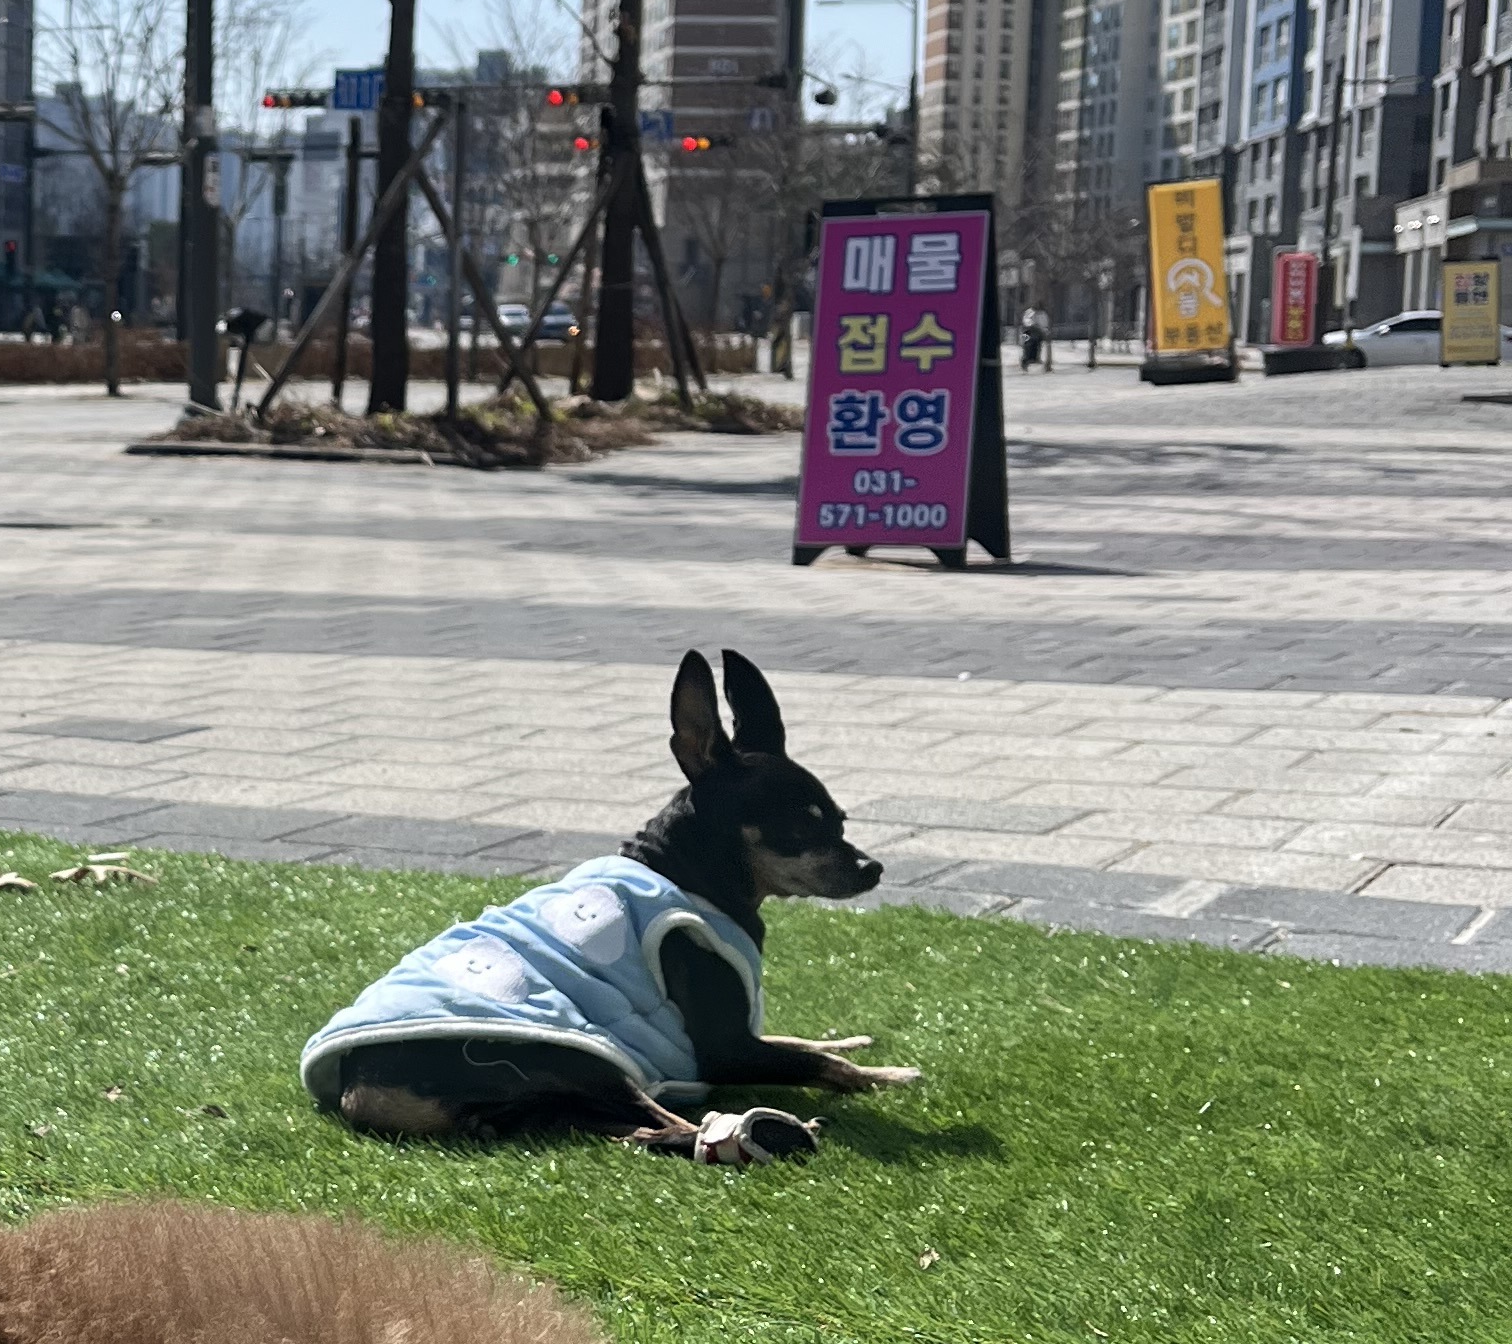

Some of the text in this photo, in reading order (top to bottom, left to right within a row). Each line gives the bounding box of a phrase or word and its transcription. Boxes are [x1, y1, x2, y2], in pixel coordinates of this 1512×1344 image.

[843, 232, 962, 293] 매물
[839, 312, 954, 374] 접수
[828, 389, 951, 456] 환영
[853, 470, 918, 494] 031-
[818, 504, 948, 530] 571-1000
